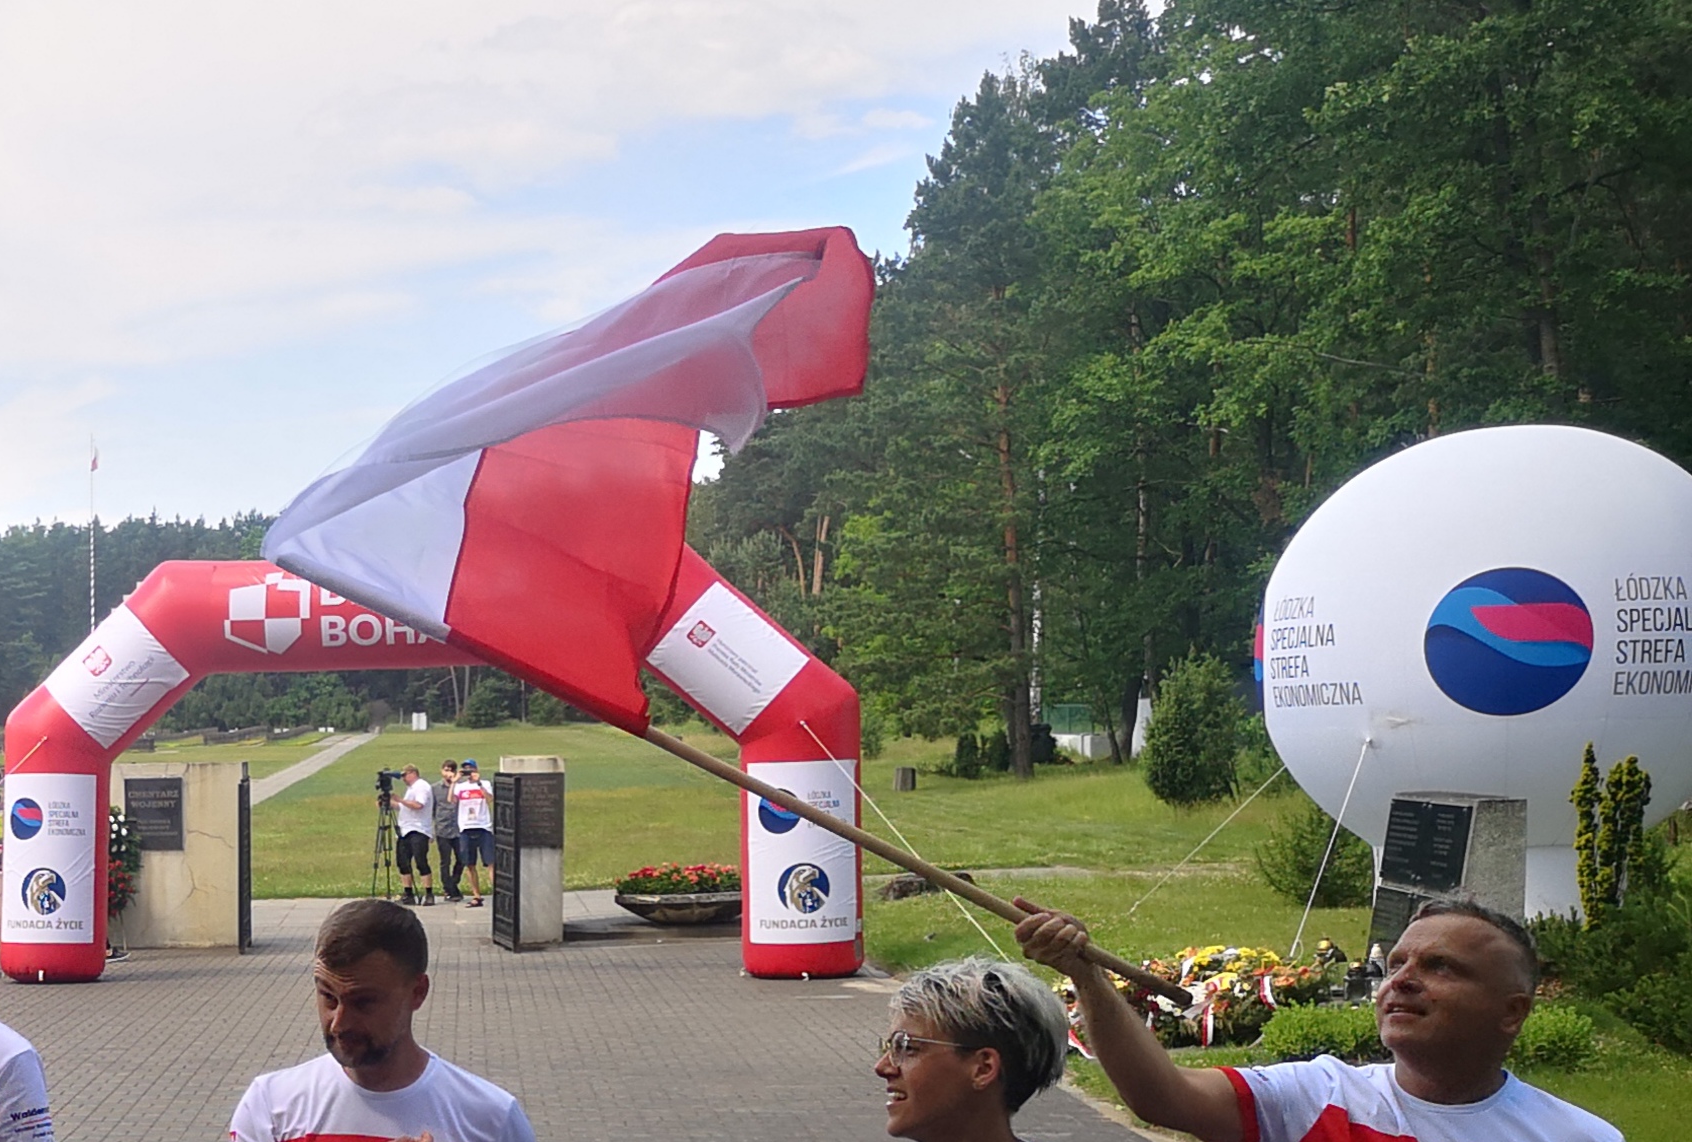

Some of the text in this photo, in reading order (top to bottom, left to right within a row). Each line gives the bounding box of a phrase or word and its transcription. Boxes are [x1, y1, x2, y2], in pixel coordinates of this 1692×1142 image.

[1612, 572, 1688, 601] ŁÓDZKA
[1273, 595, 1314, 622] ŁÓDZKA
[1270, 623, 1335, 651] SPECJALNA
[1615, 638, 1685, 665] STREFA
[1270, 655, 1309, 680] STREFA
[1273, 682, 1363, 708] EKONOMICZNA
[55, 917, 84, 930] ŻYCIE
[821, 915, 848, 929] ŻYCIE
